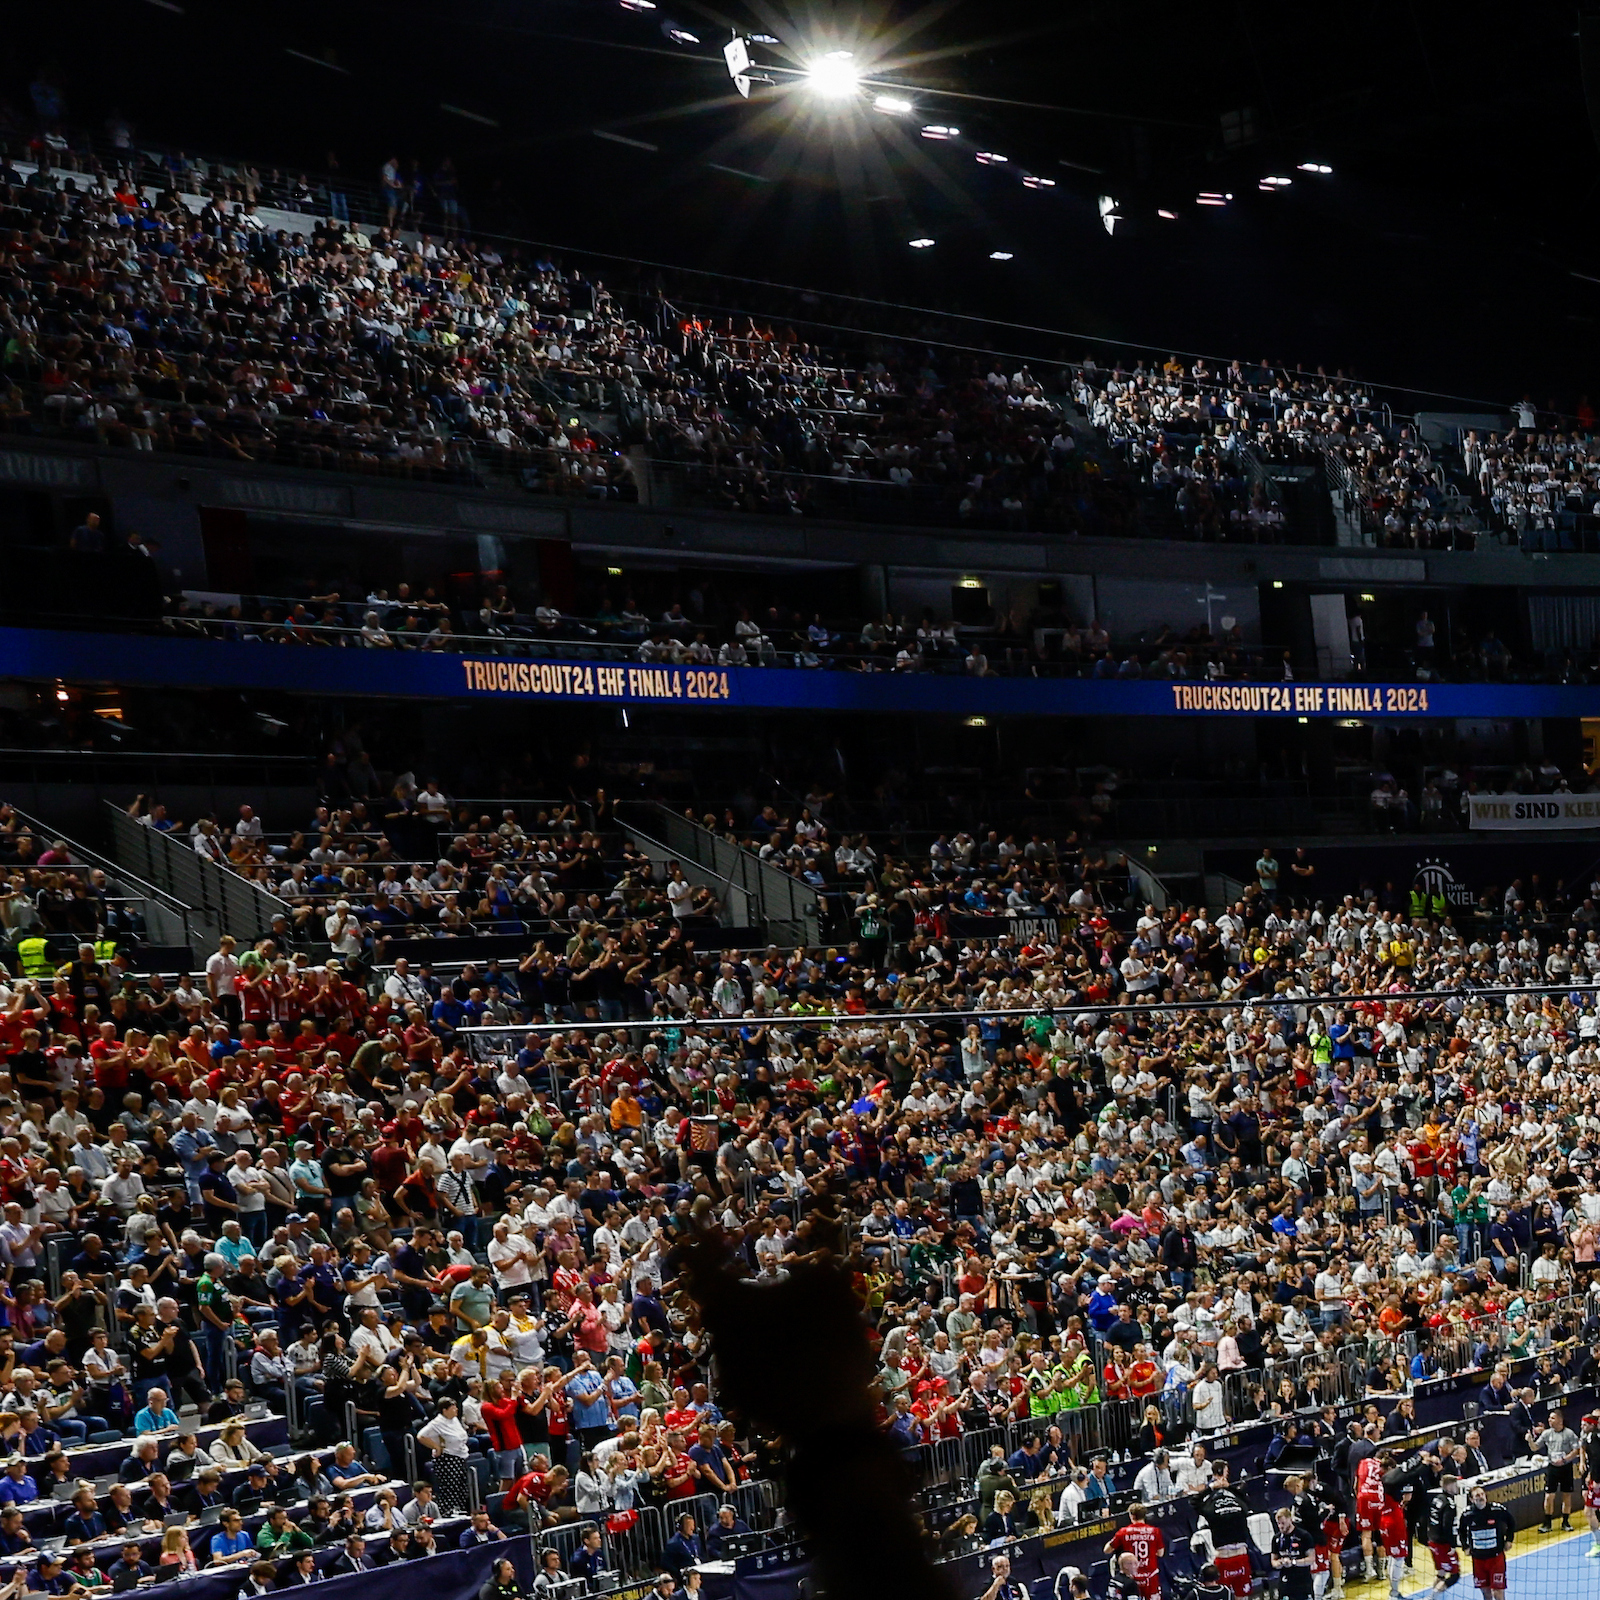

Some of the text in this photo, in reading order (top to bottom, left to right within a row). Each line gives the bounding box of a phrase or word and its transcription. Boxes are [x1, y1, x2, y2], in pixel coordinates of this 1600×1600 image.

[462, 660, 729, 699] TRUCKSCOUT24 EHF FINAL4 2024
[1172, 685, 1428, 712] TRUCKSCOUT24 EHF FINAL4 2024
[1473, 803, 1512, 820] WIR
[1514, 802, 1560, 820] SIND
[1446, 883, 1466, 892] THW
[1446, 891, 1479, 906] KIEL
[1131, 1540, 1149, 1560] 19
